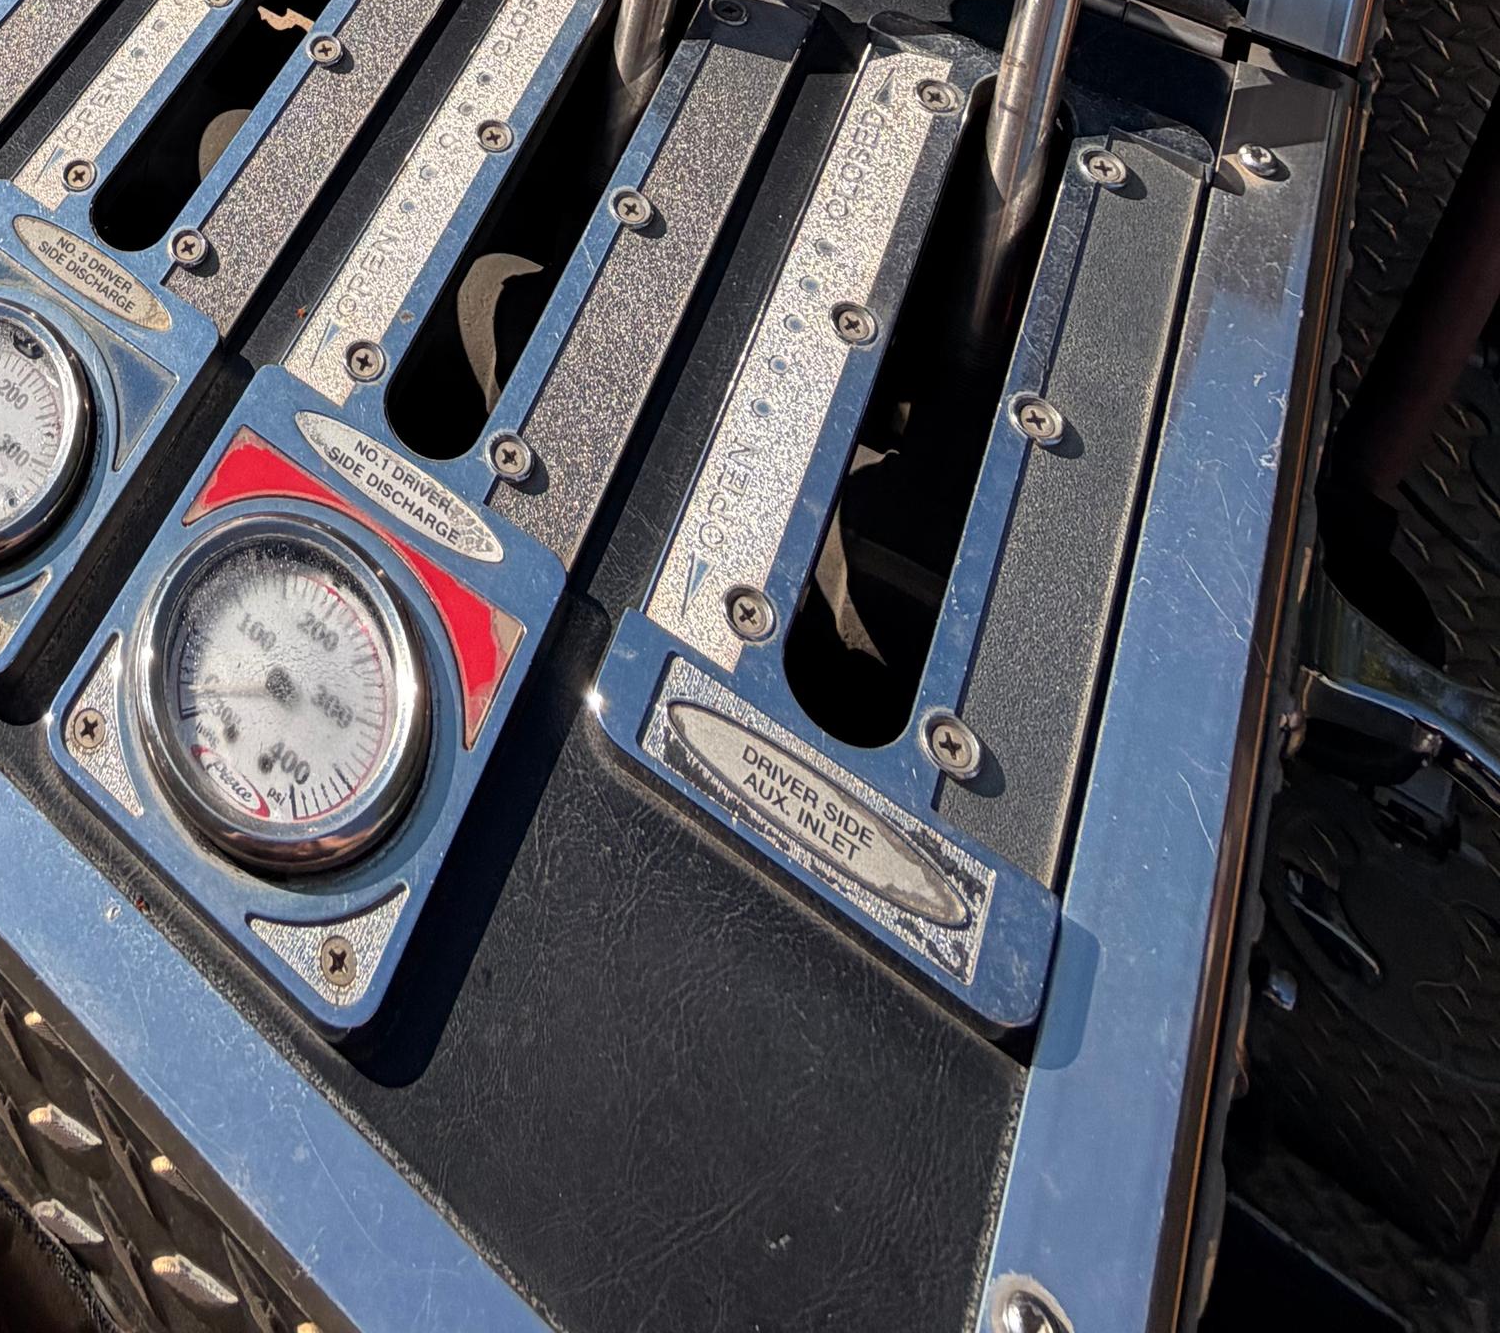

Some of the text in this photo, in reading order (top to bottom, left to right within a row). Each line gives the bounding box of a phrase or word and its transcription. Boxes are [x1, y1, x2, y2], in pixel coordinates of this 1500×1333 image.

[62, 66, 134, 145] OPEN
[826, 108, 886, 220] CLOSED
[38, 240, 137, 314] SIDE DISCHARGE
[56, 236, 133, 294] NO. 3 DRIVER
[336, 231, 400, 317] OPEN
[327, 446, 462, 545] SIDE DISCHARGE
[391, 466, 452, 515] DRIVER
[700, 439, 759, 550] OPEN
[237, 612, 277, 652] 100
[299, 610, 340, 653] 200
[311, 685, 354, 730] 300
[204, 760, 253, 803] Pierce
[266, 786, 288, 806] psi
[270, 741, 311, 785] 400
[741, 744, 876, 850] DRIVER SIDE
[742, 771, 862, 861] AUX. INLET
